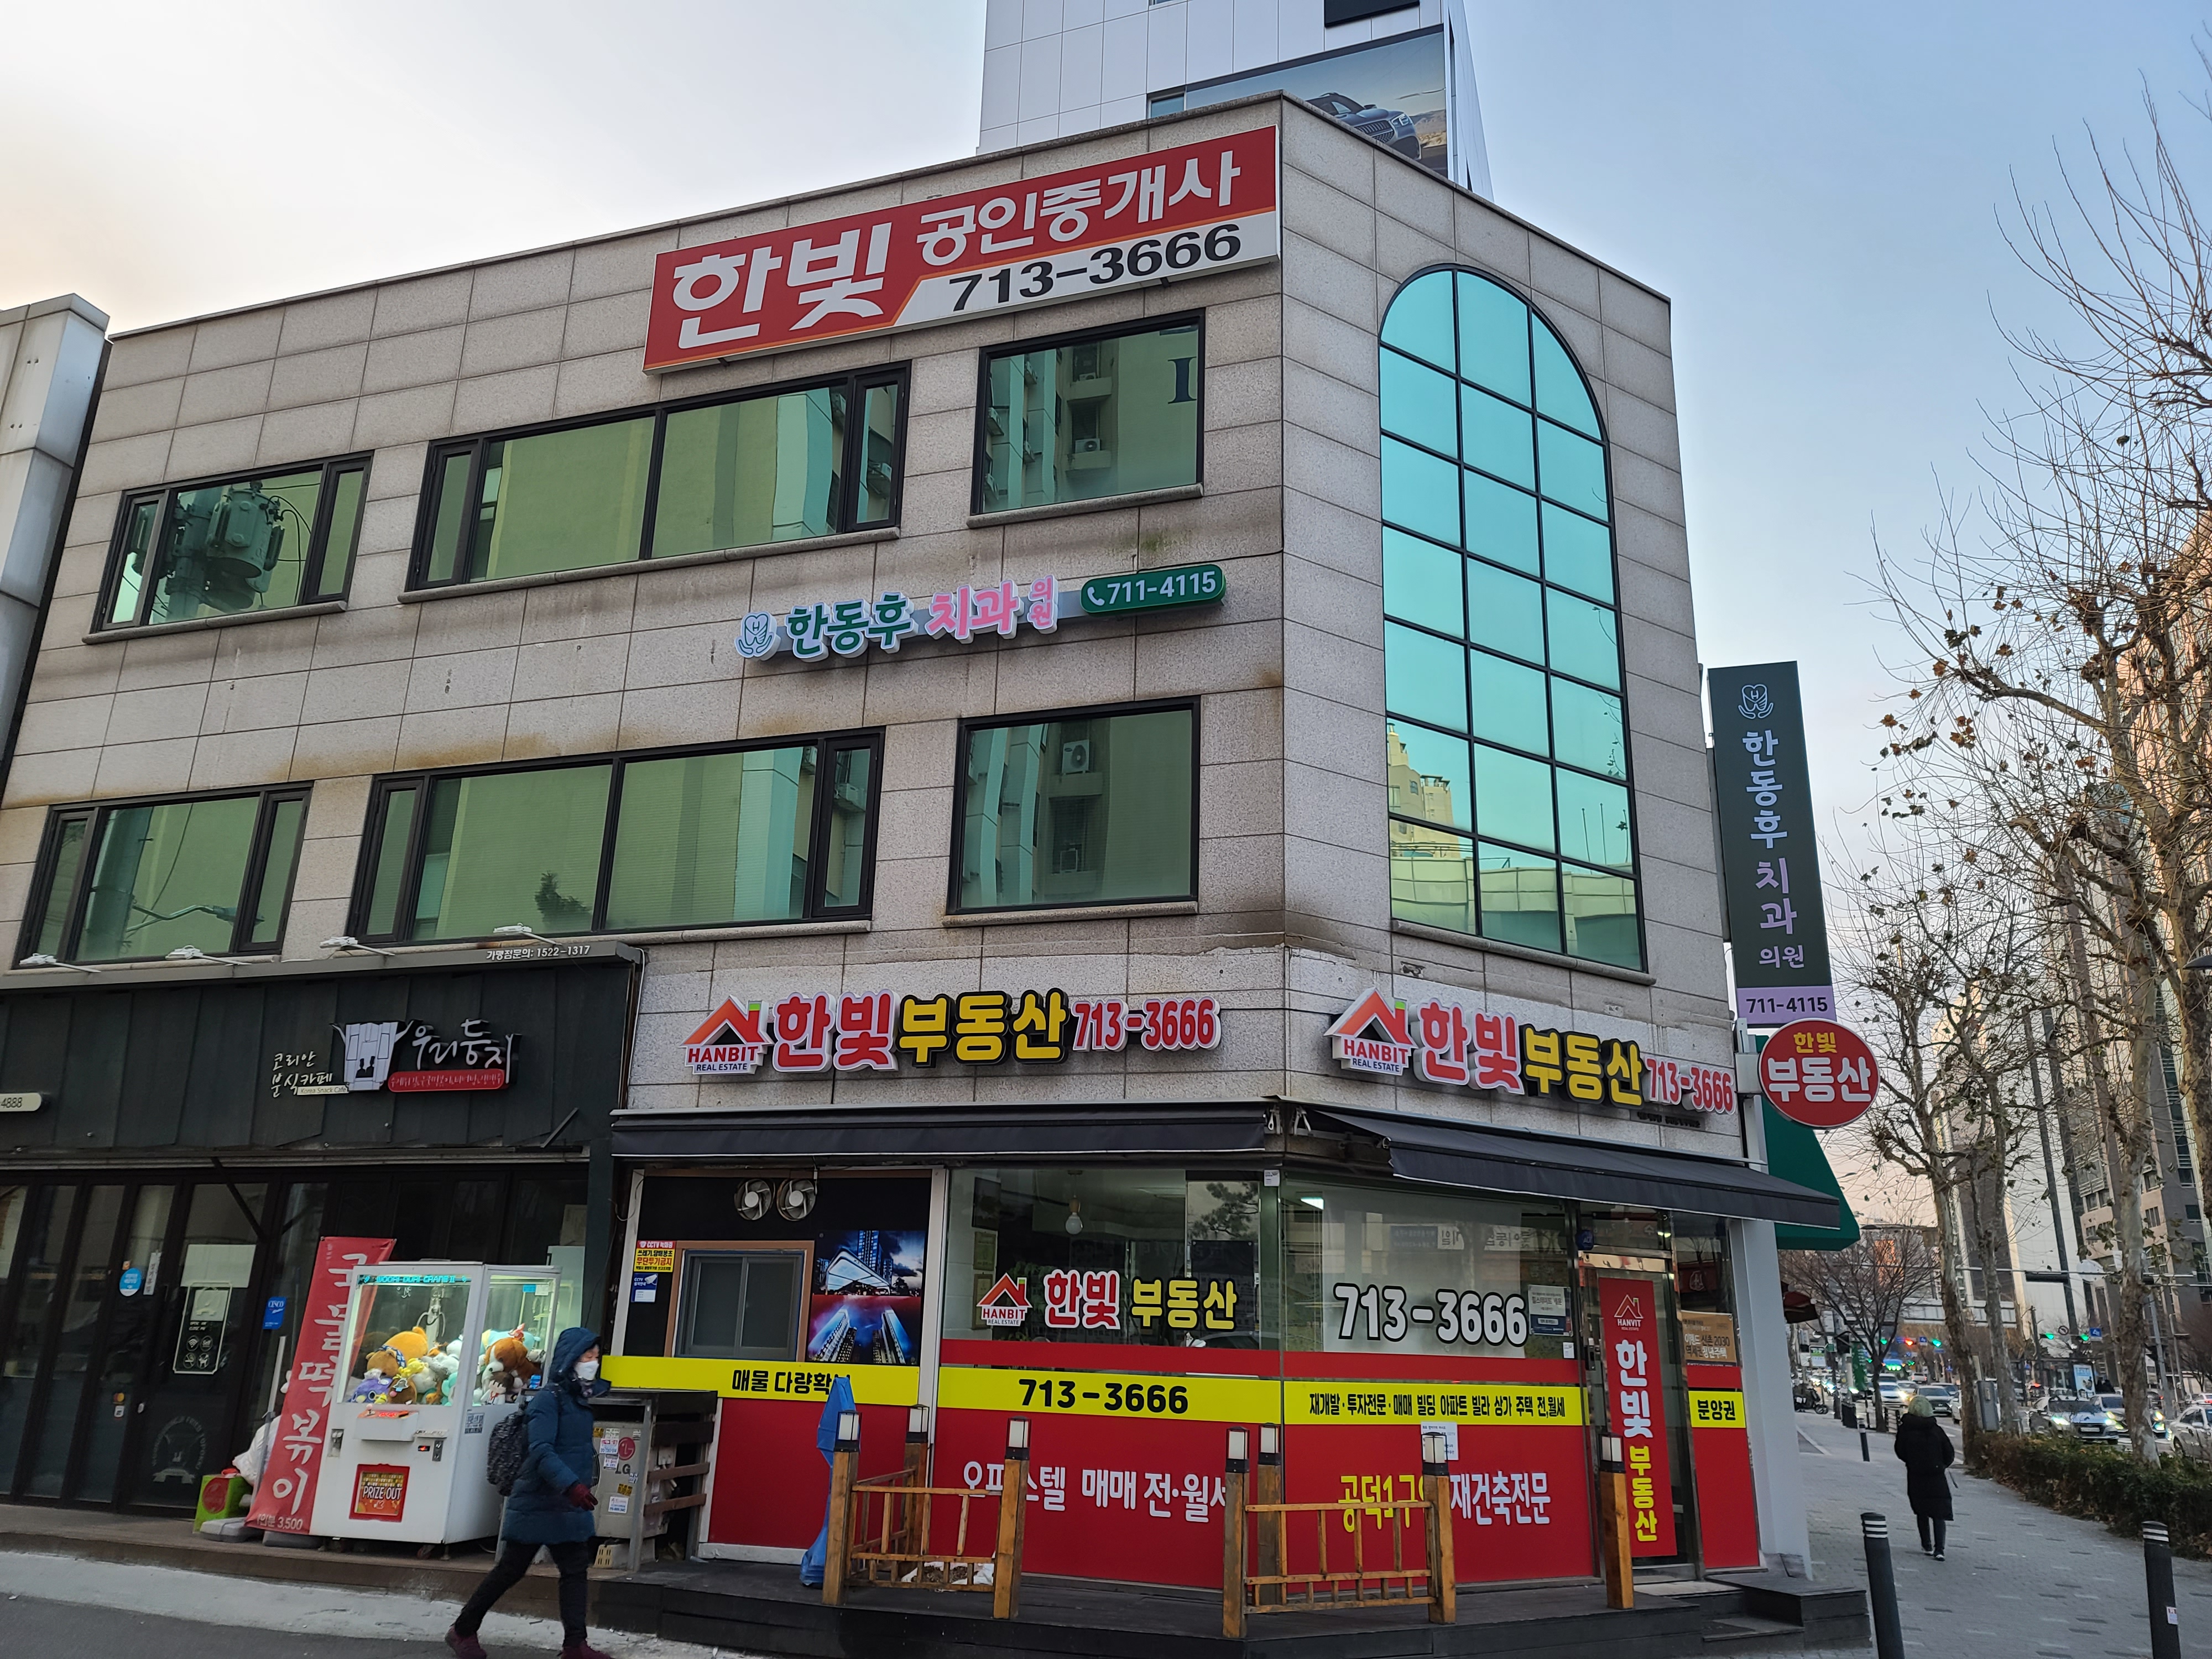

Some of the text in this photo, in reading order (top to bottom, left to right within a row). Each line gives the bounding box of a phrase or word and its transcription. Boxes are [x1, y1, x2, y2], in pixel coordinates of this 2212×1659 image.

[672, 151, 1241, 349] 한빛 공인중개사
[949, 223, 1241, 310] 713-3666
[786, 572, 1215, 655] 한동후 치과 의원 711-4115
[1742, 731, 1805, 969] 한동후 치과 의원
[537, 946, 590, 957] 1522-1317
[1746, 997, 1828, 1014] 711-4115
[773, 989, 1215, 1069] 한빛 부동산 713-3666
[1343, 1039, 1408, 1062] HANBIT
[1793, 1031, 1837, 1053] 한빛
[273, 1051, 317, 1071] 코리안
[687, 1045, 758, 1064] HANBIT
[1352, 1058, 1401, 1073] REAL ESTATE
[1419, 1001, 1733, 1112] 한빛 부동산 713-3666
[696, 1062, 748, 1072] REAL ESTATE
[271, 1072, 333, 1098] 분식카페
[1767, 1056, 1871, 1103] 부동산
[637, 1257, 672, 1266] 무단투기금지
[1045, 1271, 1237, 1329] 한빛 부동산
[982, 1308, 1025, 1319] HANBIT
[1333, 1282, 1528, 1347] 713-3666
[1617, 1318, 1642, 1327] HANVIT
[1714, 1336, 1730, 1347] 2030
[732, 1369, 851, 1395] 매물 다량확
[1615, 1339, 1653, 1439] 한빛
[1019, 1379, 1188, 1414] 713-3666
[1417, 1394, 1436, 1416] 빌딩
[1440, 1395, 1468, 1416] 아파트
[1472, 1395, 1490, 1416] 빌라
[1494, 1395, 1512, 1417] 상가
[1516, 1396, 1533, 1417] 주택
[1697, 1399, 1736, 1421] 분양권
[615, 1463, 631, 1475] LG
[362, 1485, 403, 1501] PRIZE OUT
[1082, 1469, 1136, 1510] 매매
[1338, 1470, 1551, 1533] 공덕1구 재건축전문
[1629, 1445, 1657, 1542] 부동산
